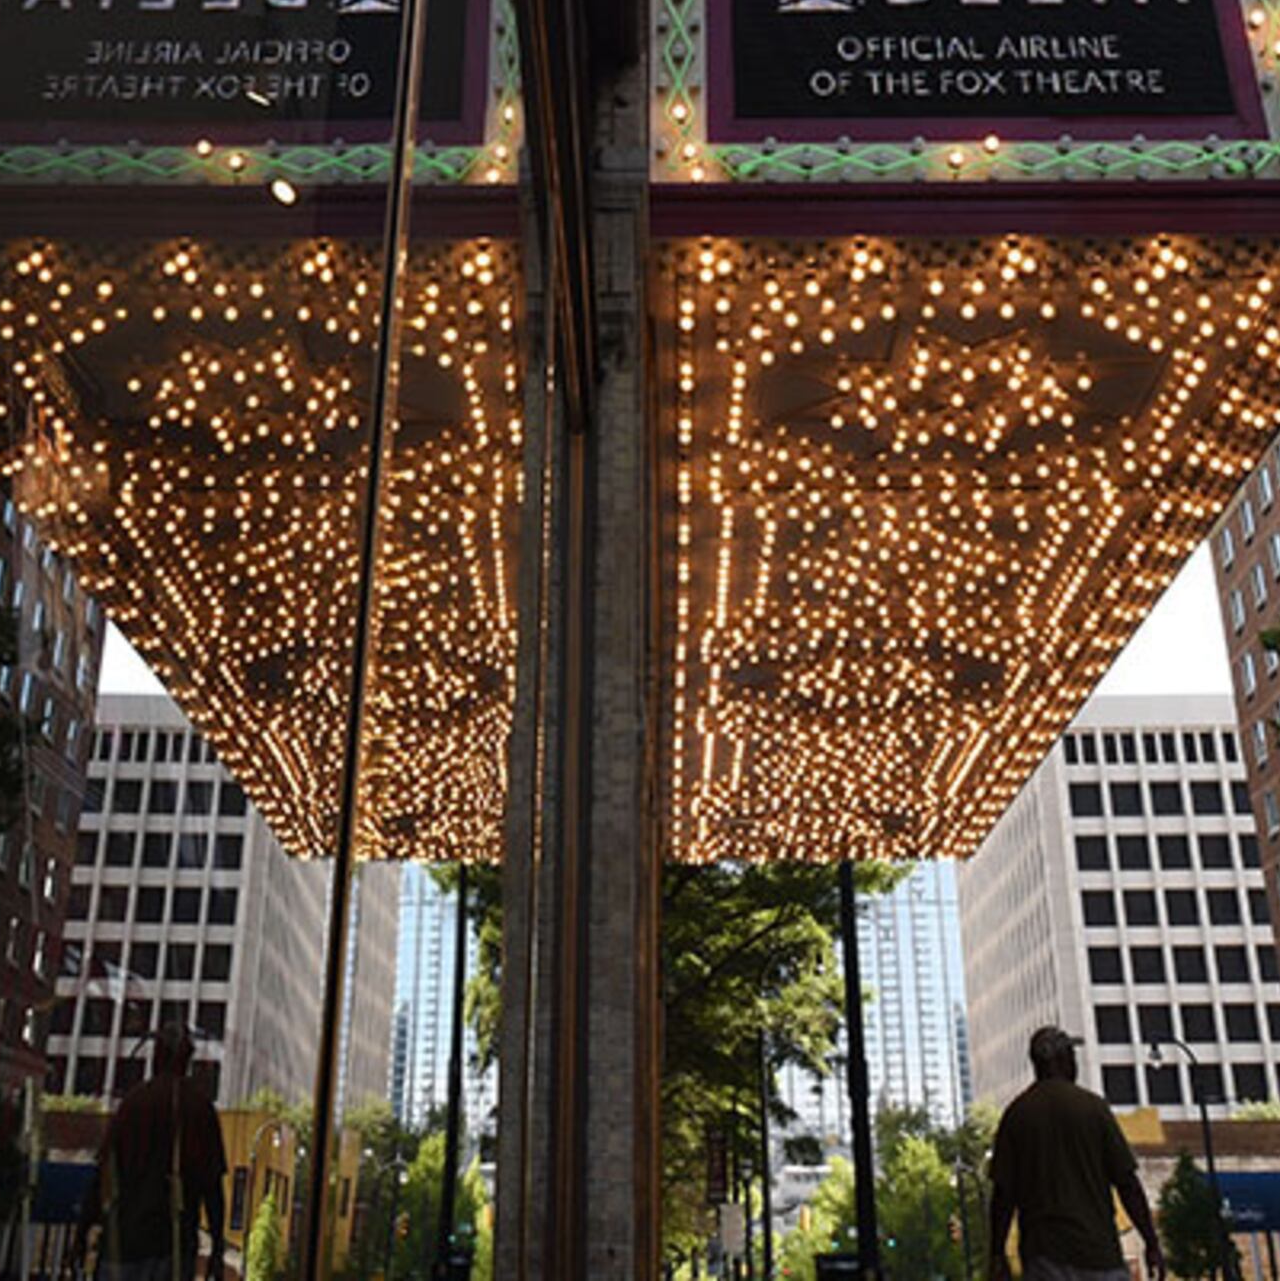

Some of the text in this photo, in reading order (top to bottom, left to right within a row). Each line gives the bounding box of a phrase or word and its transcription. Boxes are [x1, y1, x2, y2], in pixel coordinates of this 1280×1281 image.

[836, 34, 1121, 63] OFFICIAL AIRLINE
[808, 68, 1167, 97] OF THE FOX THEATRE
